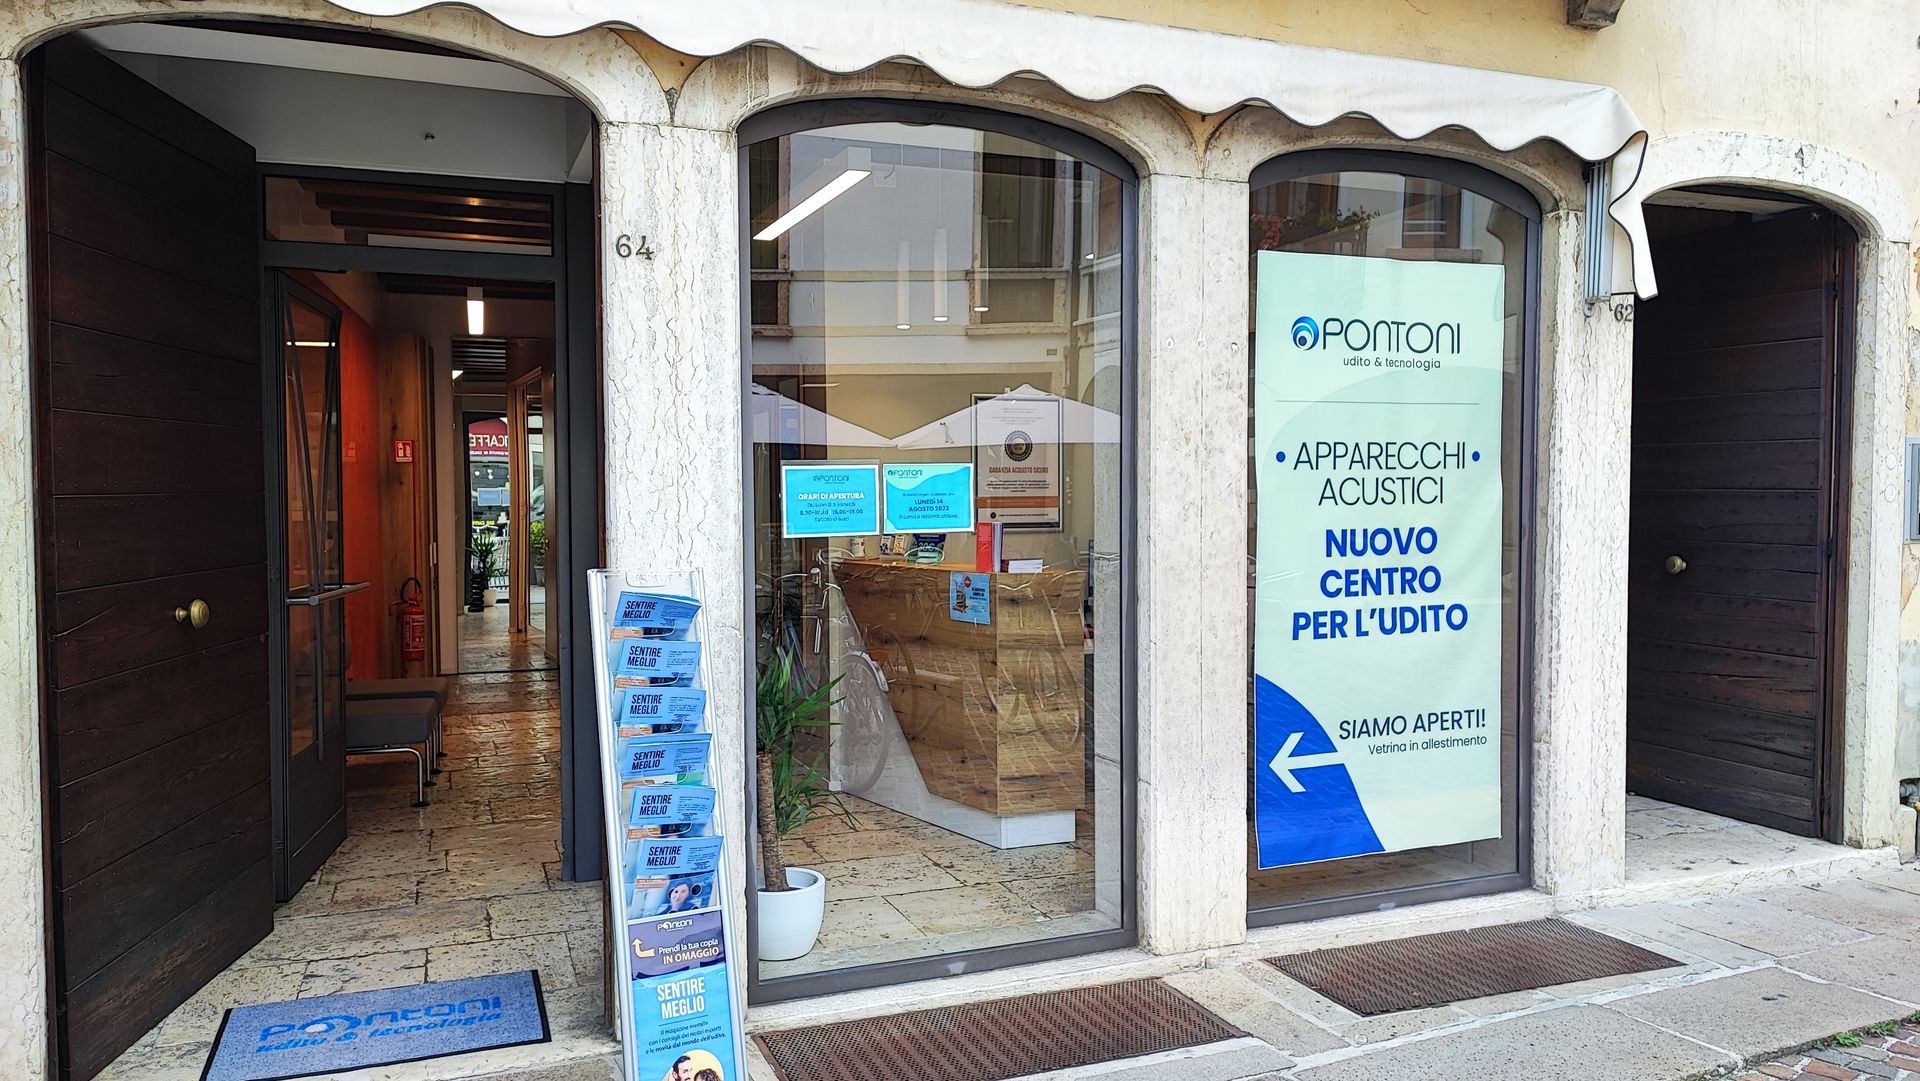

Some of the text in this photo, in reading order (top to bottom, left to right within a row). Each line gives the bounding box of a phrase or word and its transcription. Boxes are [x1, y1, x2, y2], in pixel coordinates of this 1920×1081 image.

[615, 234, 655, 260] 64
[1614, 303, 1634, 322] 62
[1343, 356, 1441, 371] udito & tecnologia
[1293, 441, 1465, 470] APPARECCHI
[989, 466, 1011, 474] GARANZIA
[829, 492, 864, 500] APERTURA
[1318, 476, 1444, 506] ACUSTICI
[1325, 526, 1438, 557] NUOVO
[1320, 565, 1441, 598] CENTRO
[625, 600, 658, 610] SENTIRE
[622, 609, 650, 619] MEGLIO
[1292, 603, 1468, 640] PER L'UDITO
[629, 645, 662, 657] SENTIRE
[627, 656, 657, 667] MEGLIO
[631, 694, 663, 704] SENTIRE
[629, 704, 658, 715] MEGLIO
[1339, 708, 1486, 740] SIAMO APERTI!
[1368, 734, 1487, 755] Vetrina in allestimento
[633, 750, 666, 761] SENTIRE
[631, 760, 661, 770] MEGLIO
[641, 794, 672, 805] SENTIRE
[639, 805, 667, 816] MEGLIO
[648, 845, 682, 856] SENTIRE
[646, 856, 677, 867] MEGLIO
[658, 943, 680, 954] Prendi
[688, 942, 699, 950] tua
[700, 938, 719, 948] copia
[663, 946, 719, 965] IN OMAGGIO
[657, 976, 706, 1002] SENTIRE
[661, 995, 705, 1020] MEGLIO
[255, 1037, 328, 1054] udito
[368, 1012, 501, 1038] tecnologia
[655, 1043, 672, 1052] novità
[673, 1041, 681, 1049] dal
[682, 1037, 700, 1047] mondo
